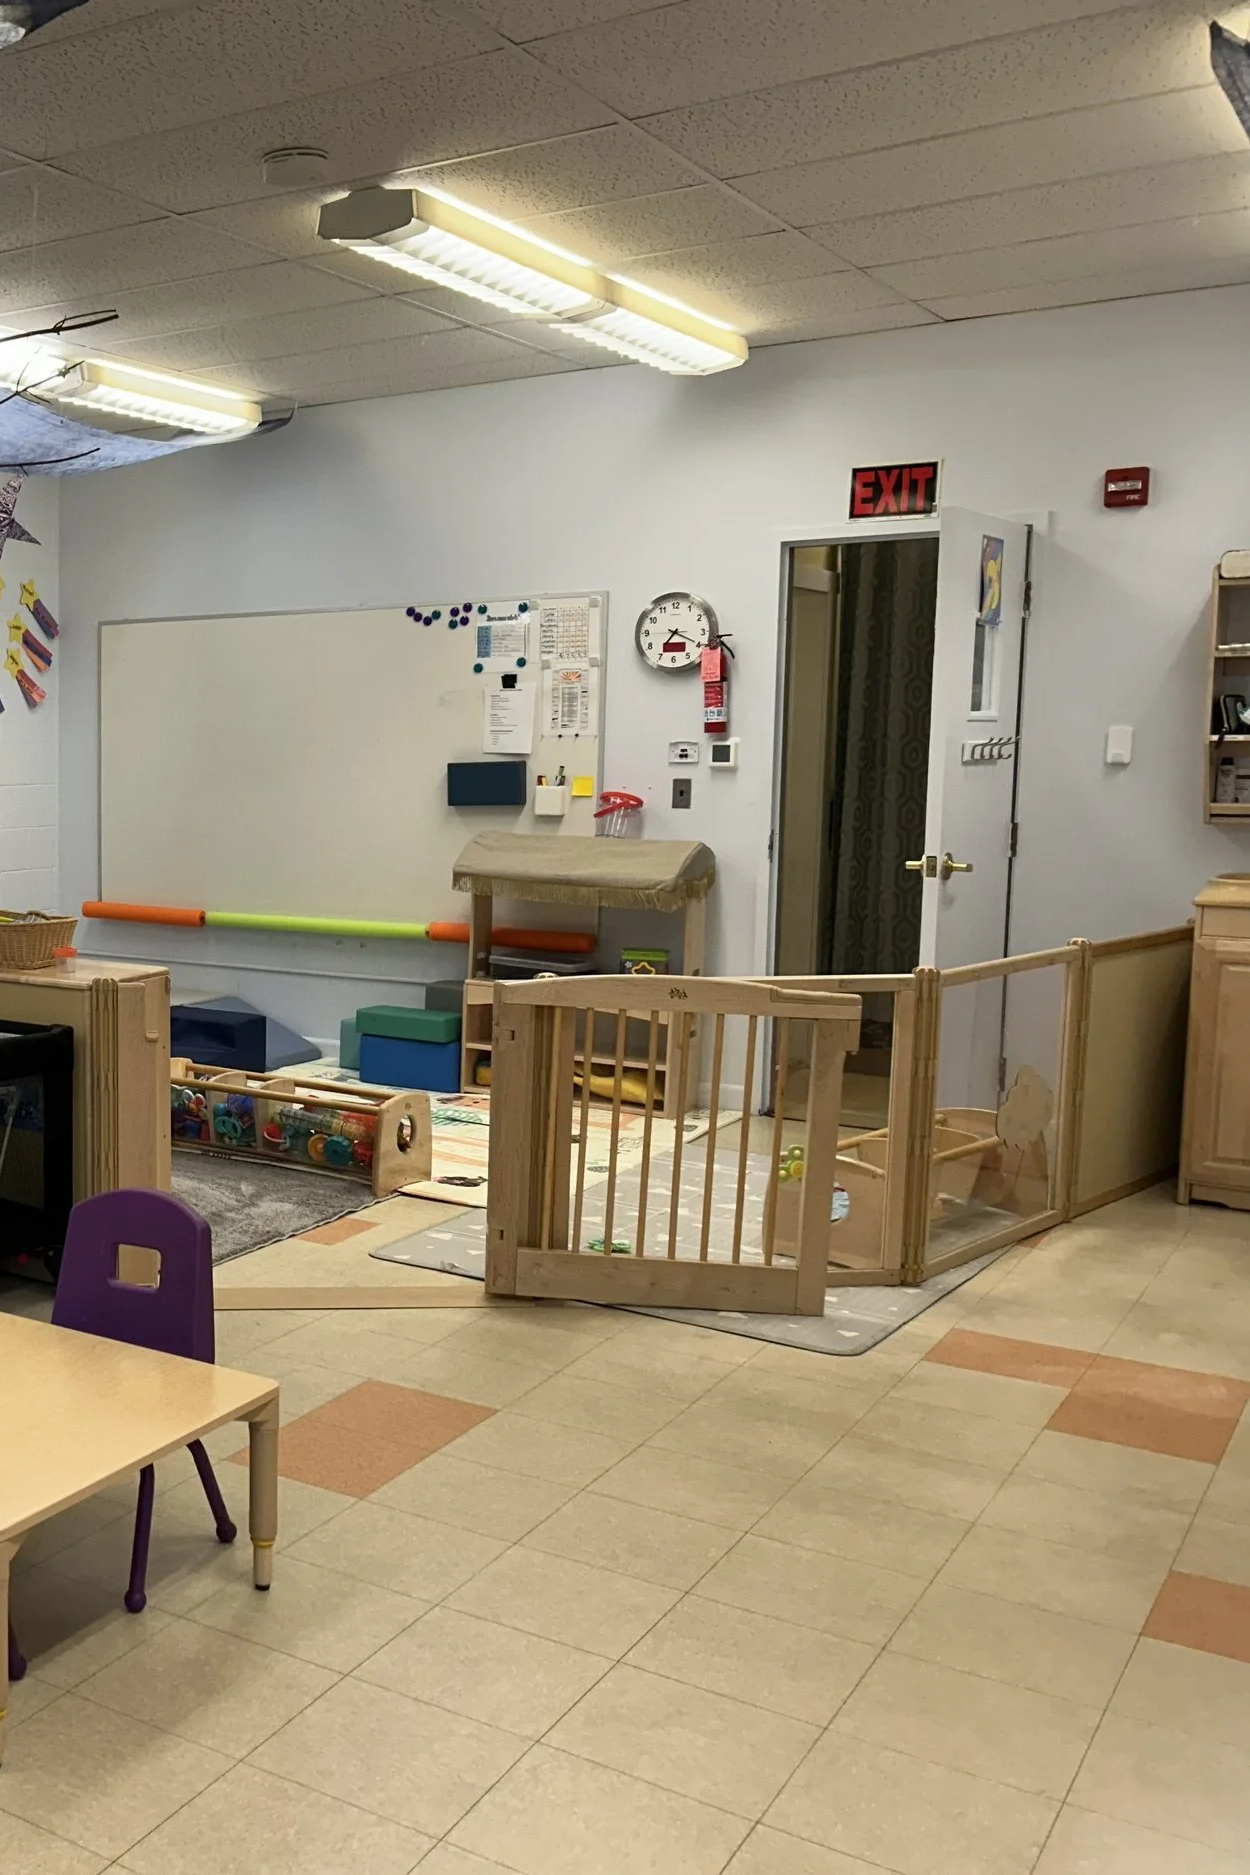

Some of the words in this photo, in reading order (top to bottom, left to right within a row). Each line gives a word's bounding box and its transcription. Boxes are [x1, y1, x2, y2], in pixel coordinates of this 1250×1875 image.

[853, 466, 934, 516] EXIT
[696, 614, 702, 622] 2
[686, 652, 691, 660] 5
